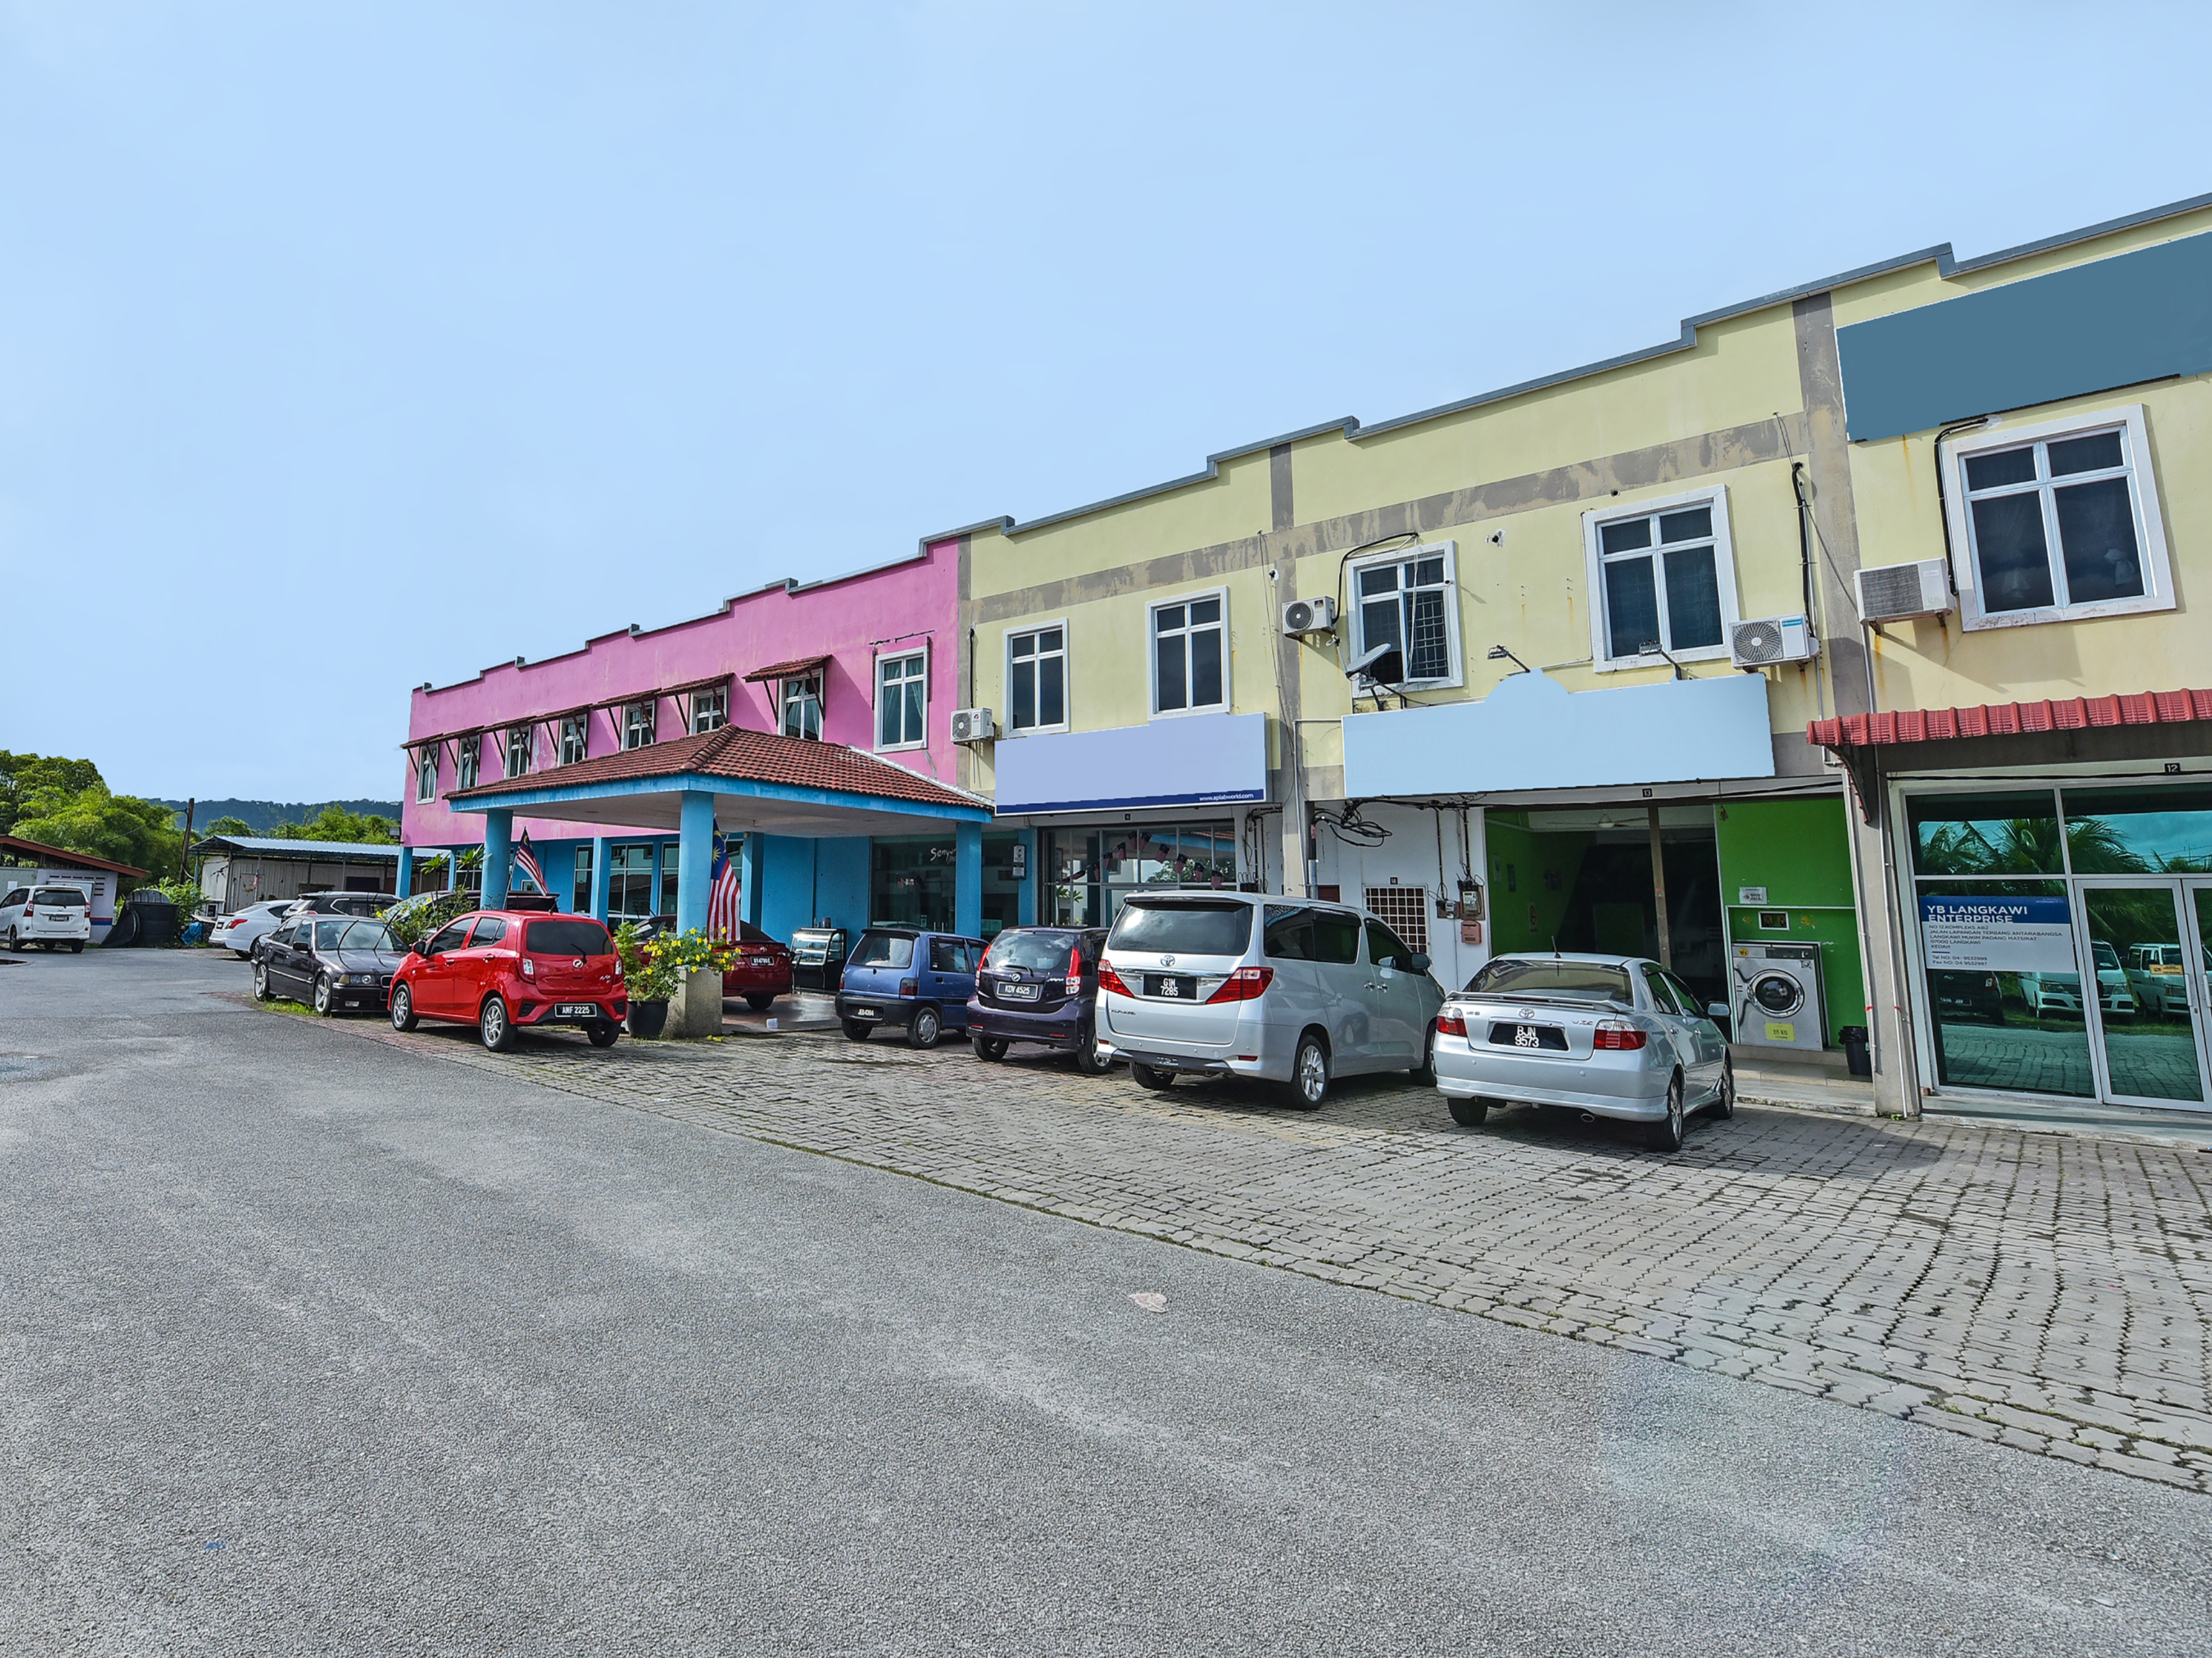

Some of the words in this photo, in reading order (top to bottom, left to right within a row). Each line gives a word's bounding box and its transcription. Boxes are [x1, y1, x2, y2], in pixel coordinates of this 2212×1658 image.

[1927, 905, 1946, 914] YB
[1949, 905, 2029, 915] LANGKAWI
[1928, 914, 2013, 924] ENTERPRISE
[1015, 986, 1030, 995] 4525
[1161, 986, 1179, 996] 7285
[1516, 1026, 1536, 1037] BJN
[1515, 1036, 1540, 1048] 9573
